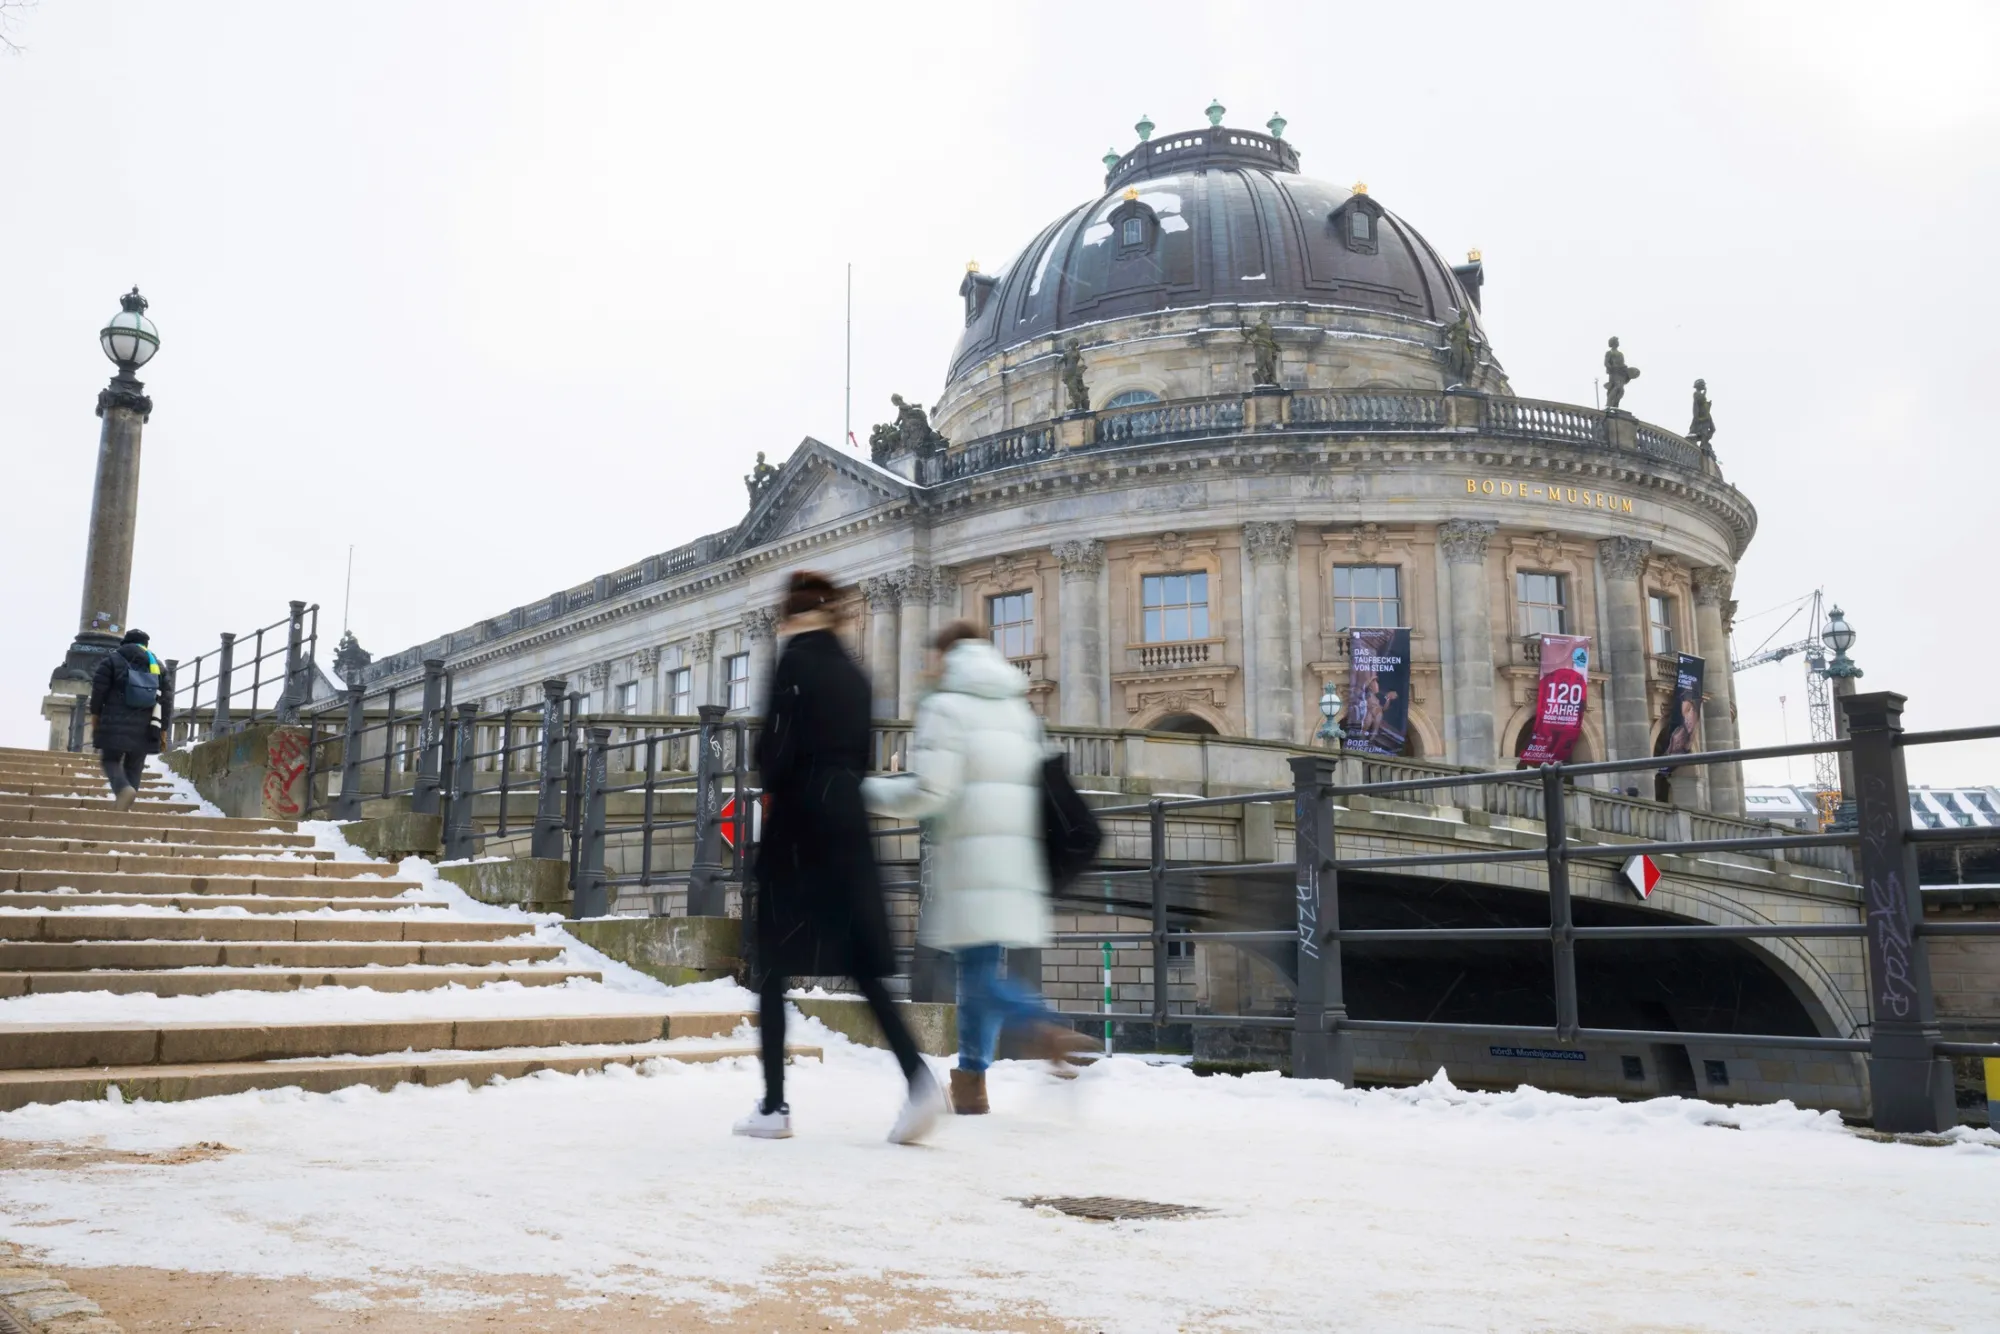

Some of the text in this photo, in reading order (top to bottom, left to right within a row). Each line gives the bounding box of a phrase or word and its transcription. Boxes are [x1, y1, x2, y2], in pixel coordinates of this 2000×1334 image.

[1466, 479, 1633, 513] BODE-MUSEUM
[1354, 648, 1369, 656] DAS
[1354, 656, 1401, 664] TAUFBECKEN
[1371, 664, 1395, 672] SIENA
[1547, 683, 1582, 705] 120
[1545, 704, 1579, 716] JAHRE
[1528, 744, 1547, 752] BODE
